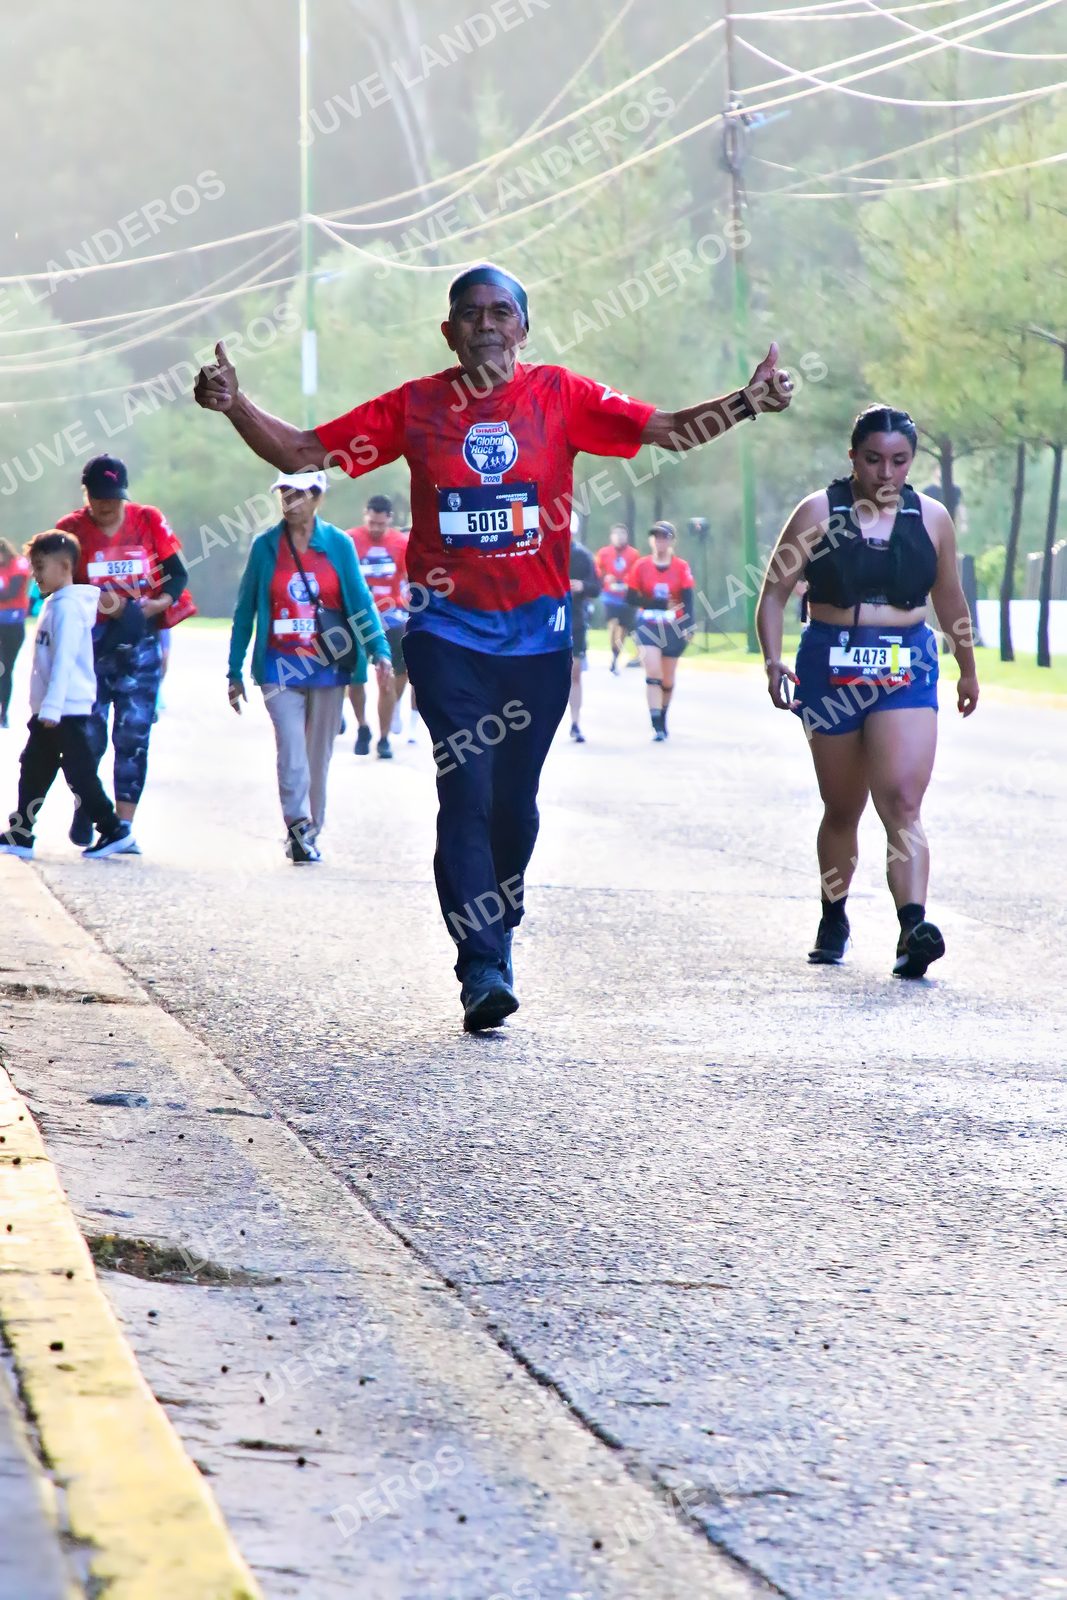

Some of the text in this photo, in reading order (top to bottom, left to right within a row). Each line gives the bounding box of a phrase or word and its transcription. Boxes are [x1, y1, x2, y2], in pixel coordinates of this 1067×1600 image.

[476, 436, 504, 446] Global
[471, 445, 494, 454] Race
[467, 511, 508, 532] 5013
[853, 649, 887, 665] 4473
